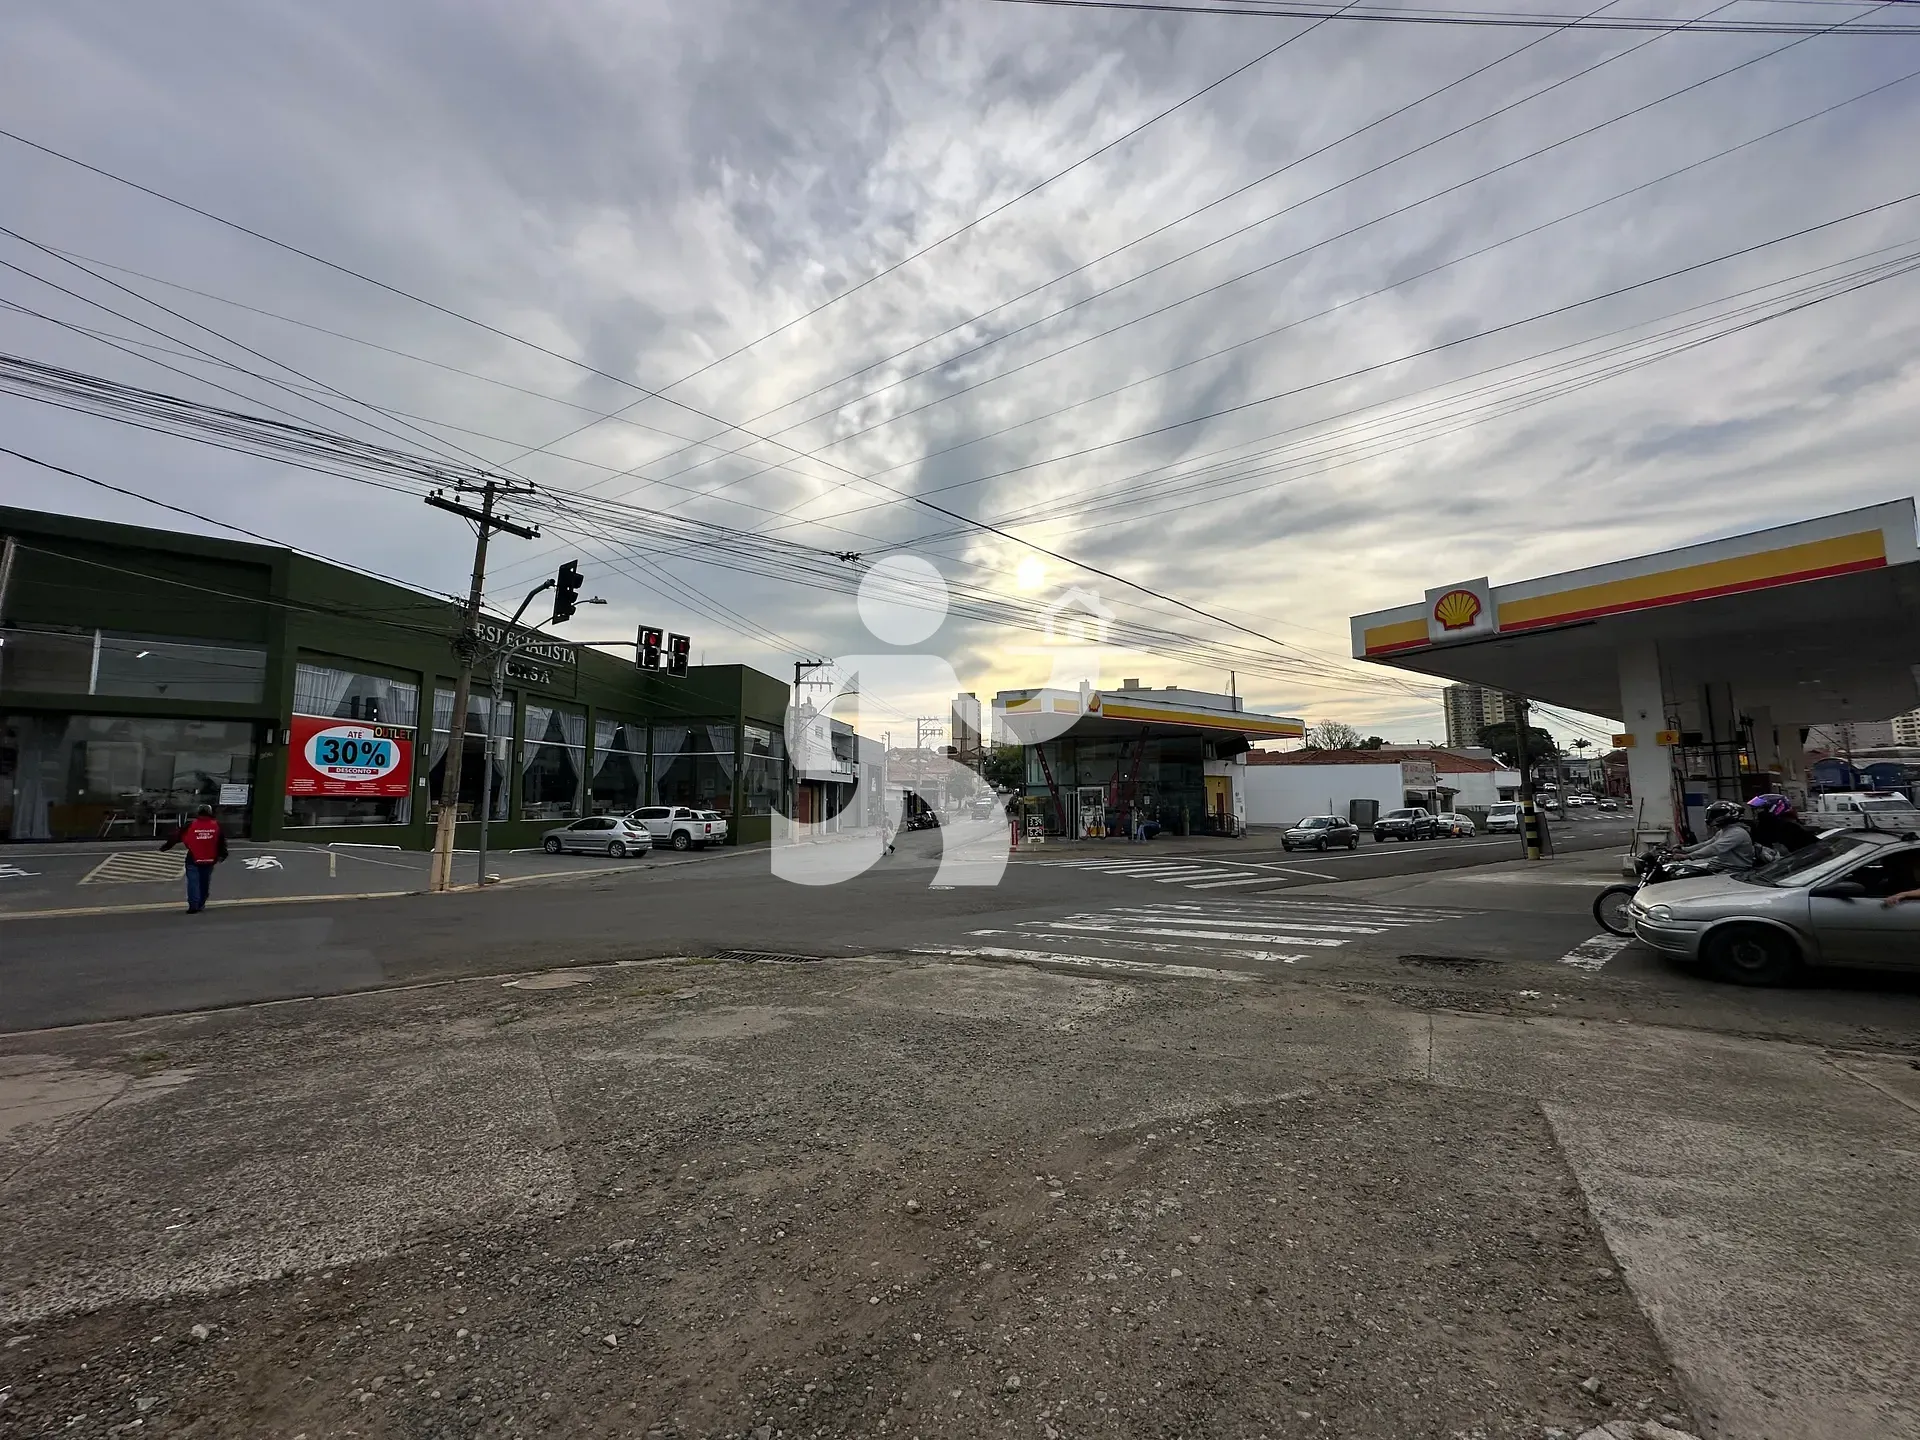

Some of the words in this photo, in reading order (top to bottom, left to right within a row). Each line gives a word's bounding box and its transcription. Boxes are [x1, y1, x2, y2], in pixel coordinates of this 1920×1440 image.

[374, 727, 412, 739] OUTLET
[322, 739, 386, 766] 30%
[336, 767, 372, 775] DESCONTO
